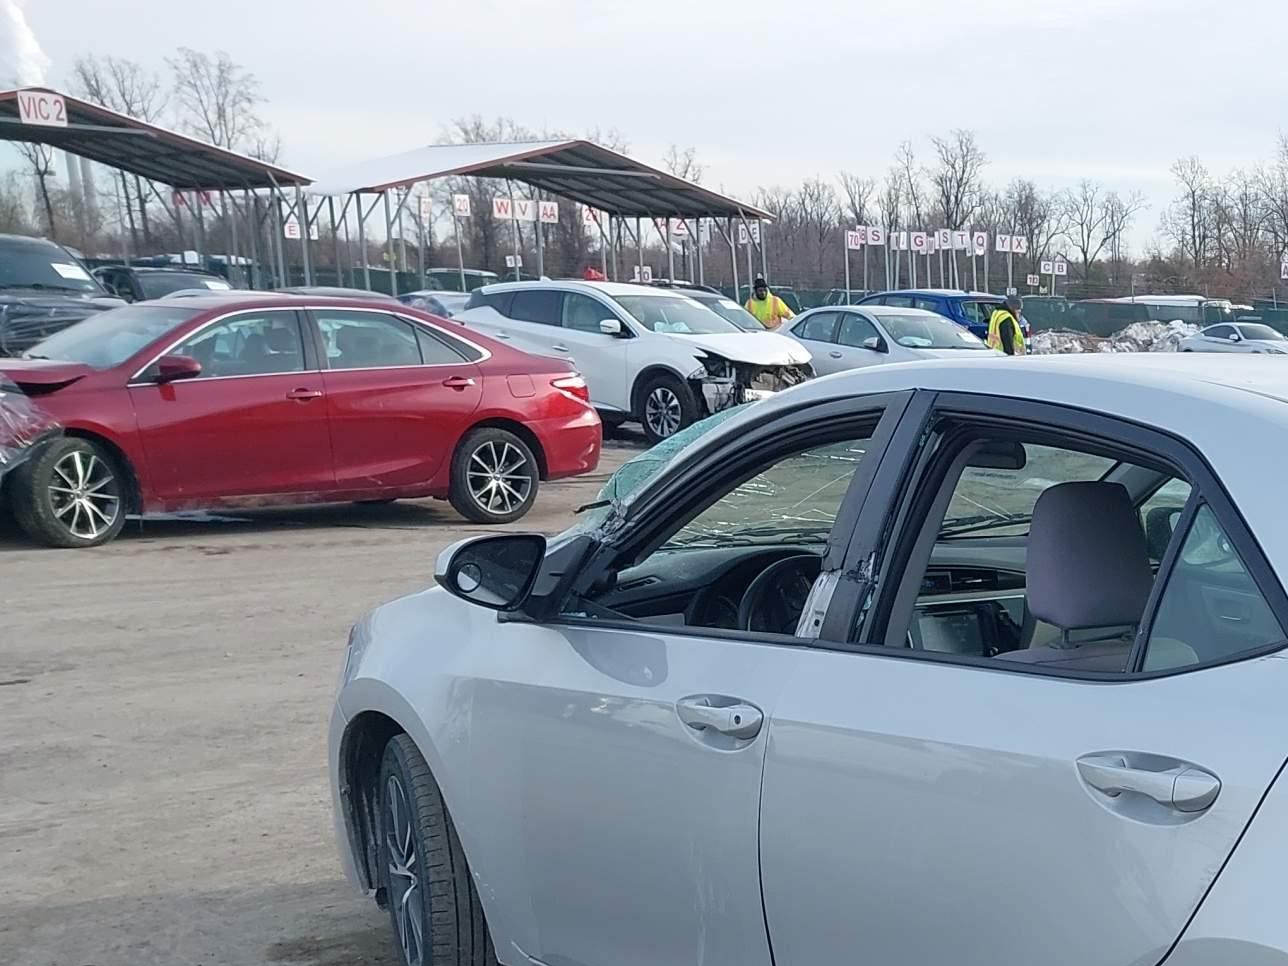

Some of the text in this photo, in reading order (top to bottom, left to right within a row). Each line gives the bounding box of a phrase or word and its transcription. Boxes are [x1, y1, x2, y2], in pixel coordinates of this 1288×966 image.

[20, 95, 65, 122] VIC 2
[495, 200, 509, 215] W
[518, 203, 528, 216] V
[542, 205, 556, 219] AA
[871, 230, 881, 242] S
[913, 235, 924, 247] G
[957, 233, 966, 245] T
[999, 236, 1007, 248] Y
[1015, 237, 1023, 249] X
[1043, 263, 1051, 272] C
